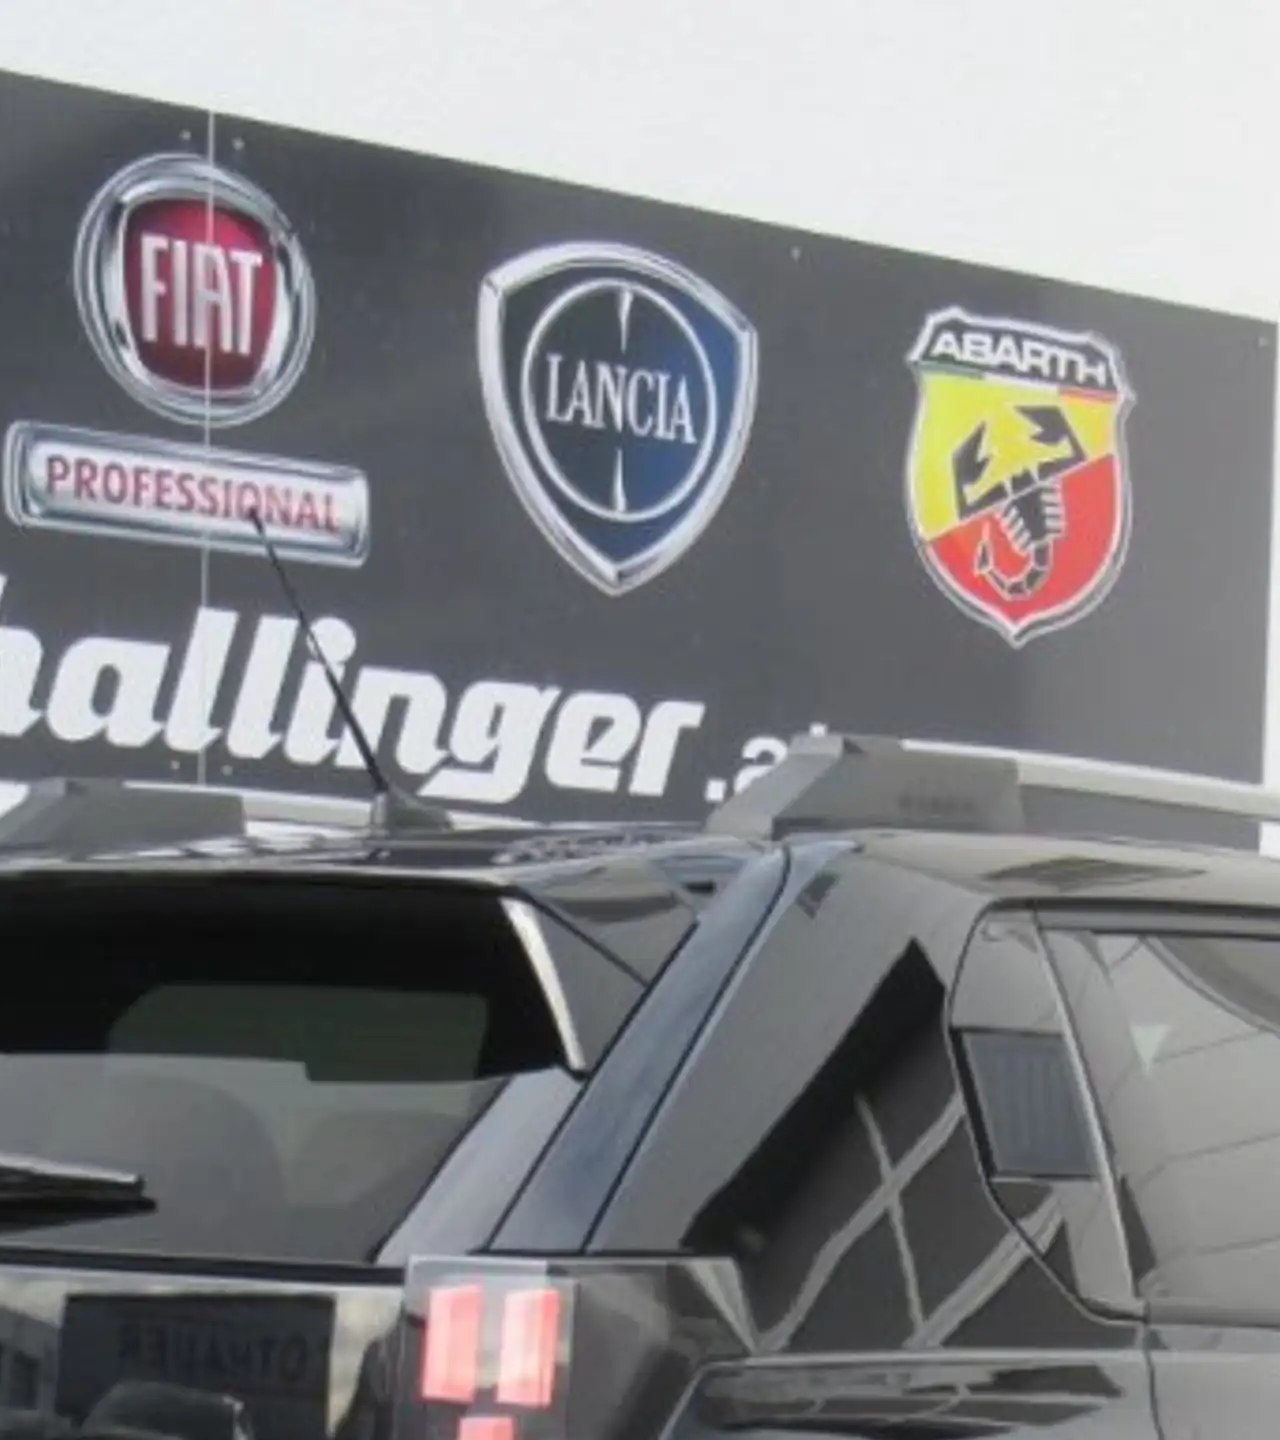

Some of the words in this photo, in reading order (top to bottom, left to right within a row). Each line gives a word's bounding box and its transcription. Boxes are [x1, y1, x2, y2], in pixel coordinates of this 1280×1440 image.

[141, 233, 263, 355] FIAT
[545, 353, 697, 443] LANCIA
[930, 330, 1107, 387] ABARTH
[46, 455, 339, 532] PROFESSIONAL
